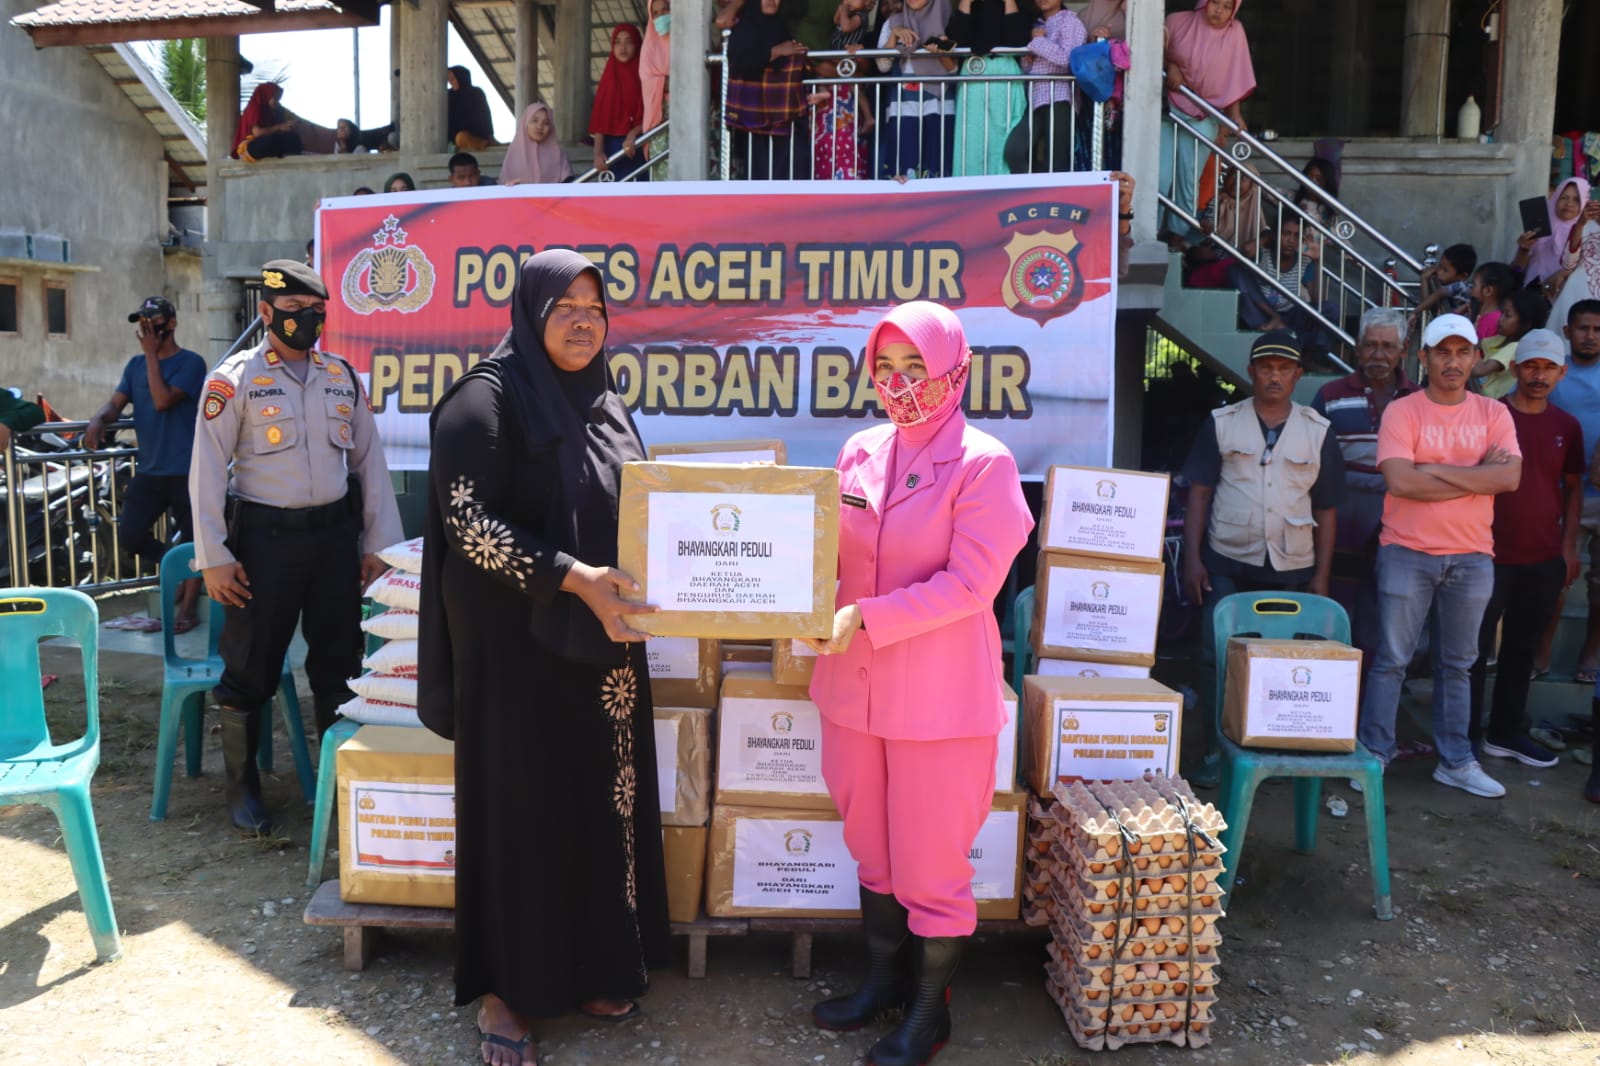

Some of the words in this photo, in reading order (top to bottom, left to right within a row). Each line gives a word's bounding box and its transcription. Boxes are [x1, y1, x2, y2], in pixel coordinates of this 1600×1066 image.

[1007, 206, 1082, 223] ACEH
[456, 250, 637, 304] POS
[650, 249, 783, 302] ACEH
[799, 247, 962, 302] TIMUR
[608, 352, 795, 409] ORBAN
[814, 353, 1028, 413] BAIR
[1072, 501, 1113, 516] BHAYANGKARI
[1114, 505, 1136, 519] PEDULI
[678, 540, 738, 556] BHAYANGKARI
[740, 542, 772, 557] PEDULI
[747, 737, 790, 749] BHAYANGKARI
[792, 738, 815, 751] PEDULI
